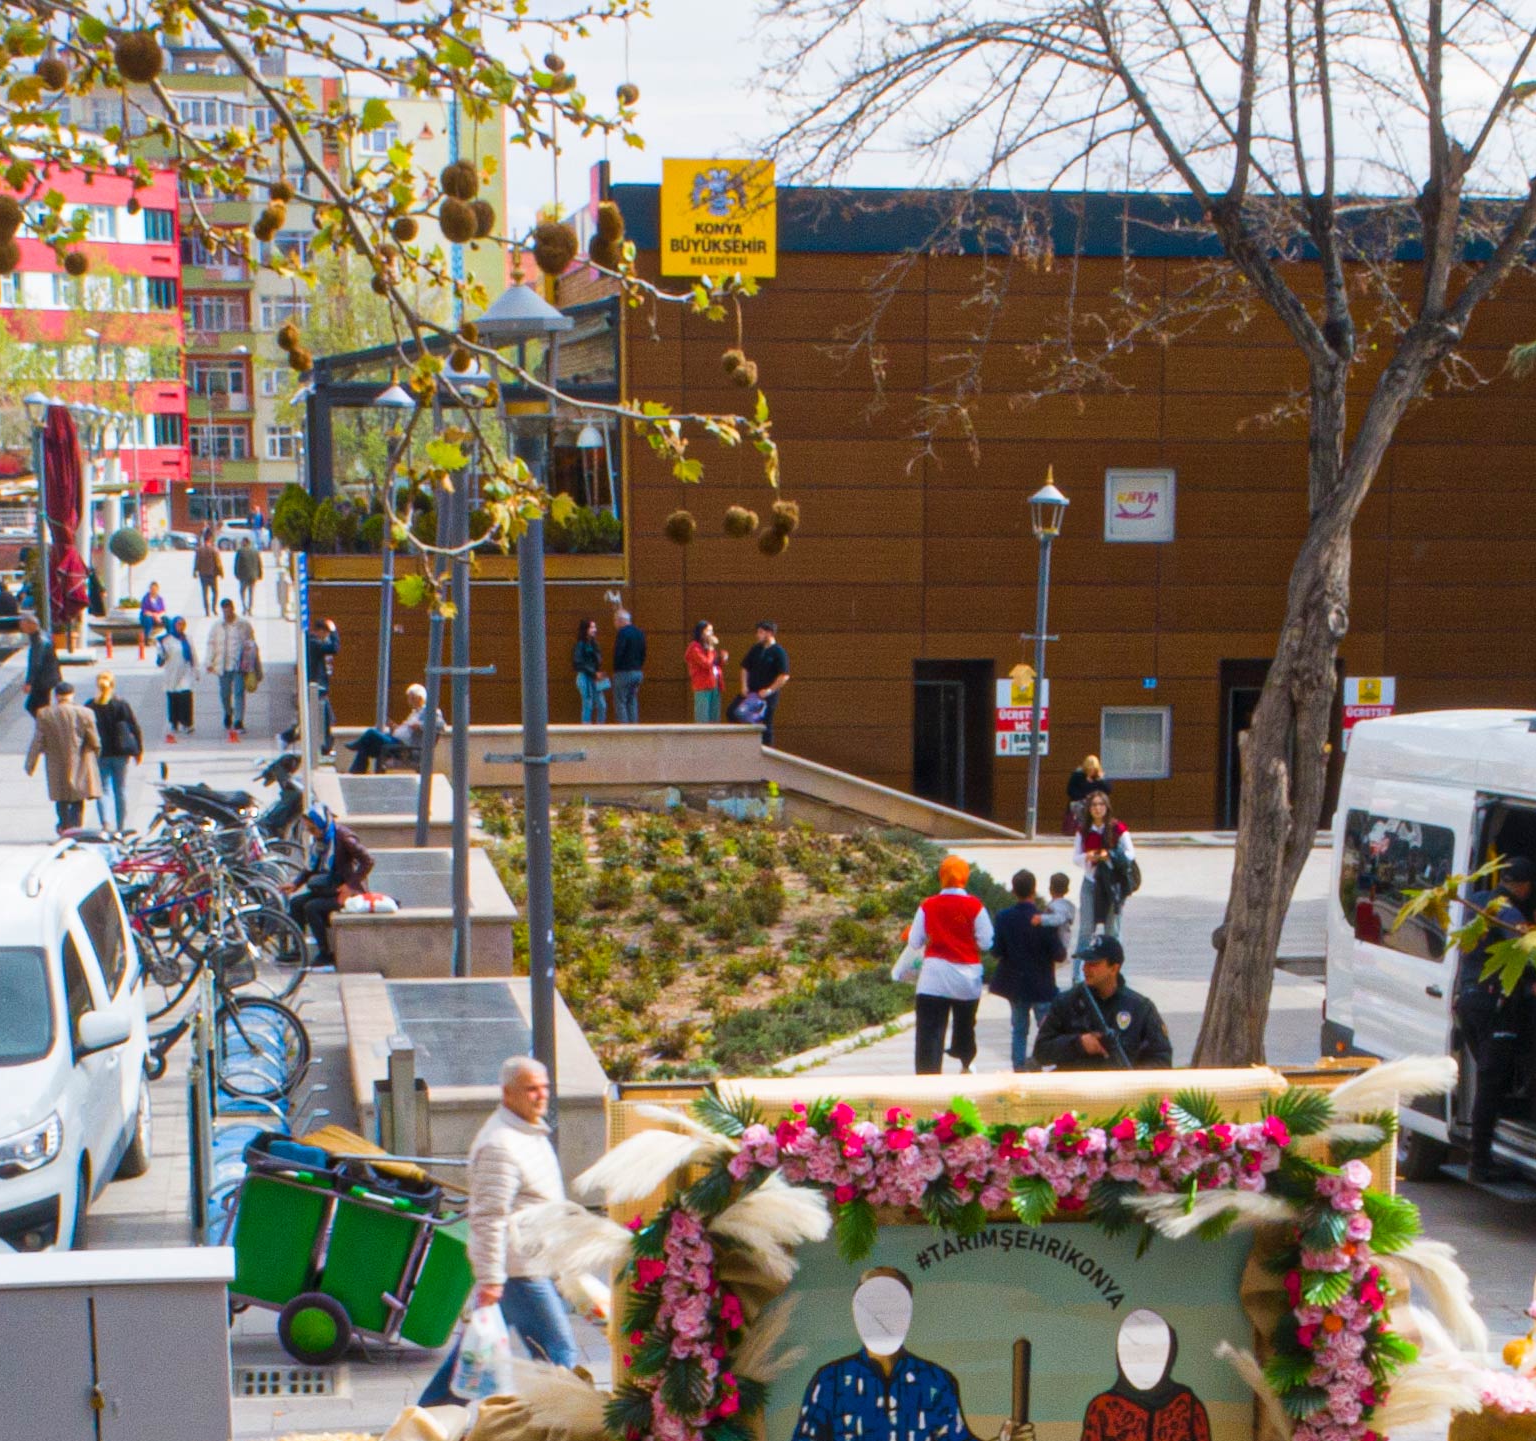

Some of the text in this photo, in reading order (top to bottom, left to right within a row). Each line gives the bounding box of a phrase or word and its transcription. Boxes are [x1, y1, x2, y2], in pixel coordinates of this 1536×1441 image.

[695, 222, 743, 235] KONYA
[670, 236, 767, 254] BÜYÜKŞEHİR
[916, 1229, 1125, 1310] #TARIMŞEHRİKONYA
